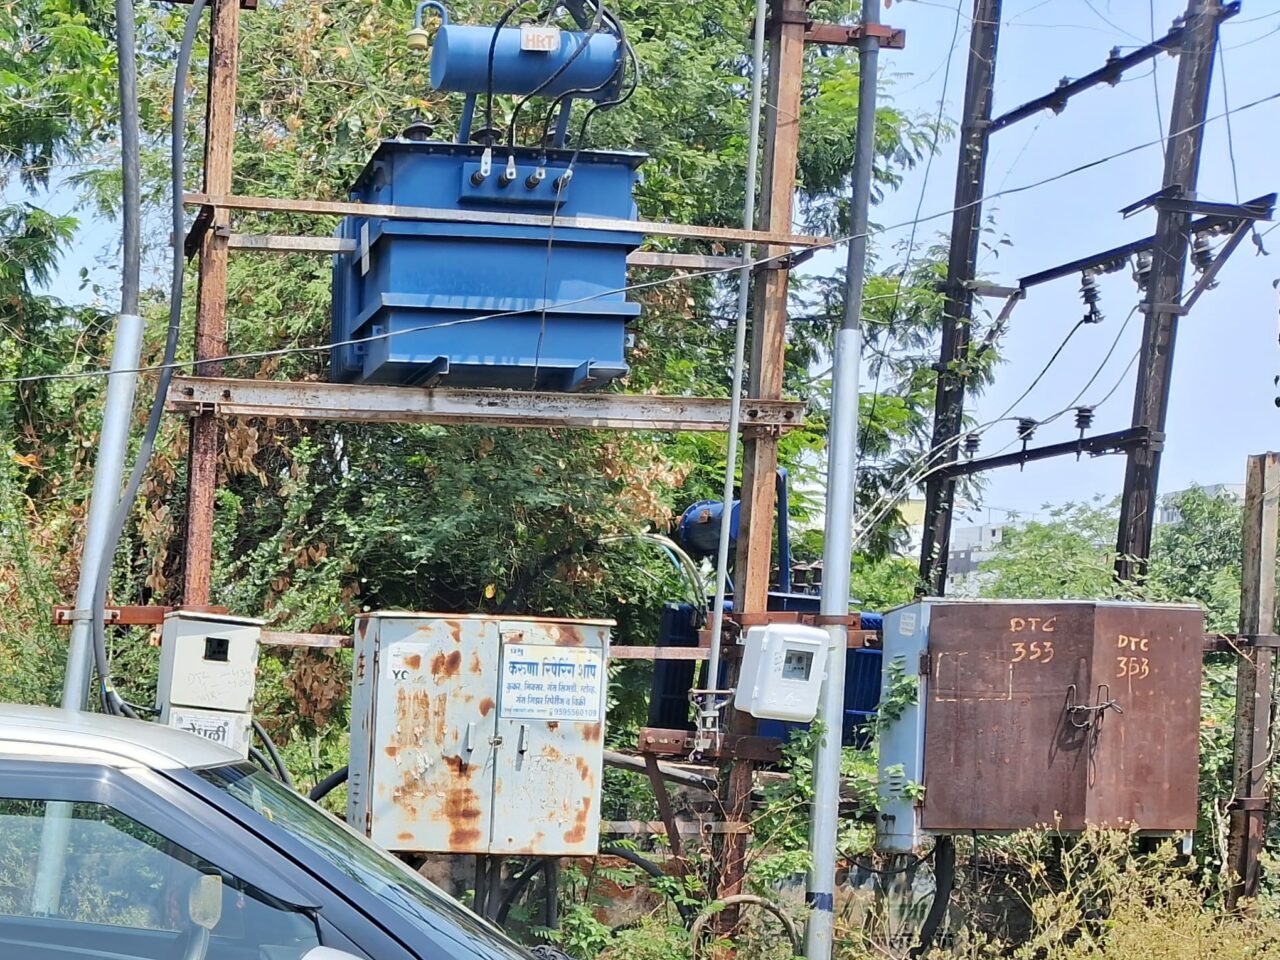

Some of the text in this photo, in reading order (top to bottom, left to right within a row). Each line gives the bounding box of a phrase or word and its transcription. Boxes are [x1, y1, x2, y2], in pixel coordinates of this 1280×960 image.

[1009, 616, 1056, 632] DTC
[1117, 634, 1149, 651] DTC
[1011, 641, 1055, 663] 353
[509, 661, 539, 676] करुणा
